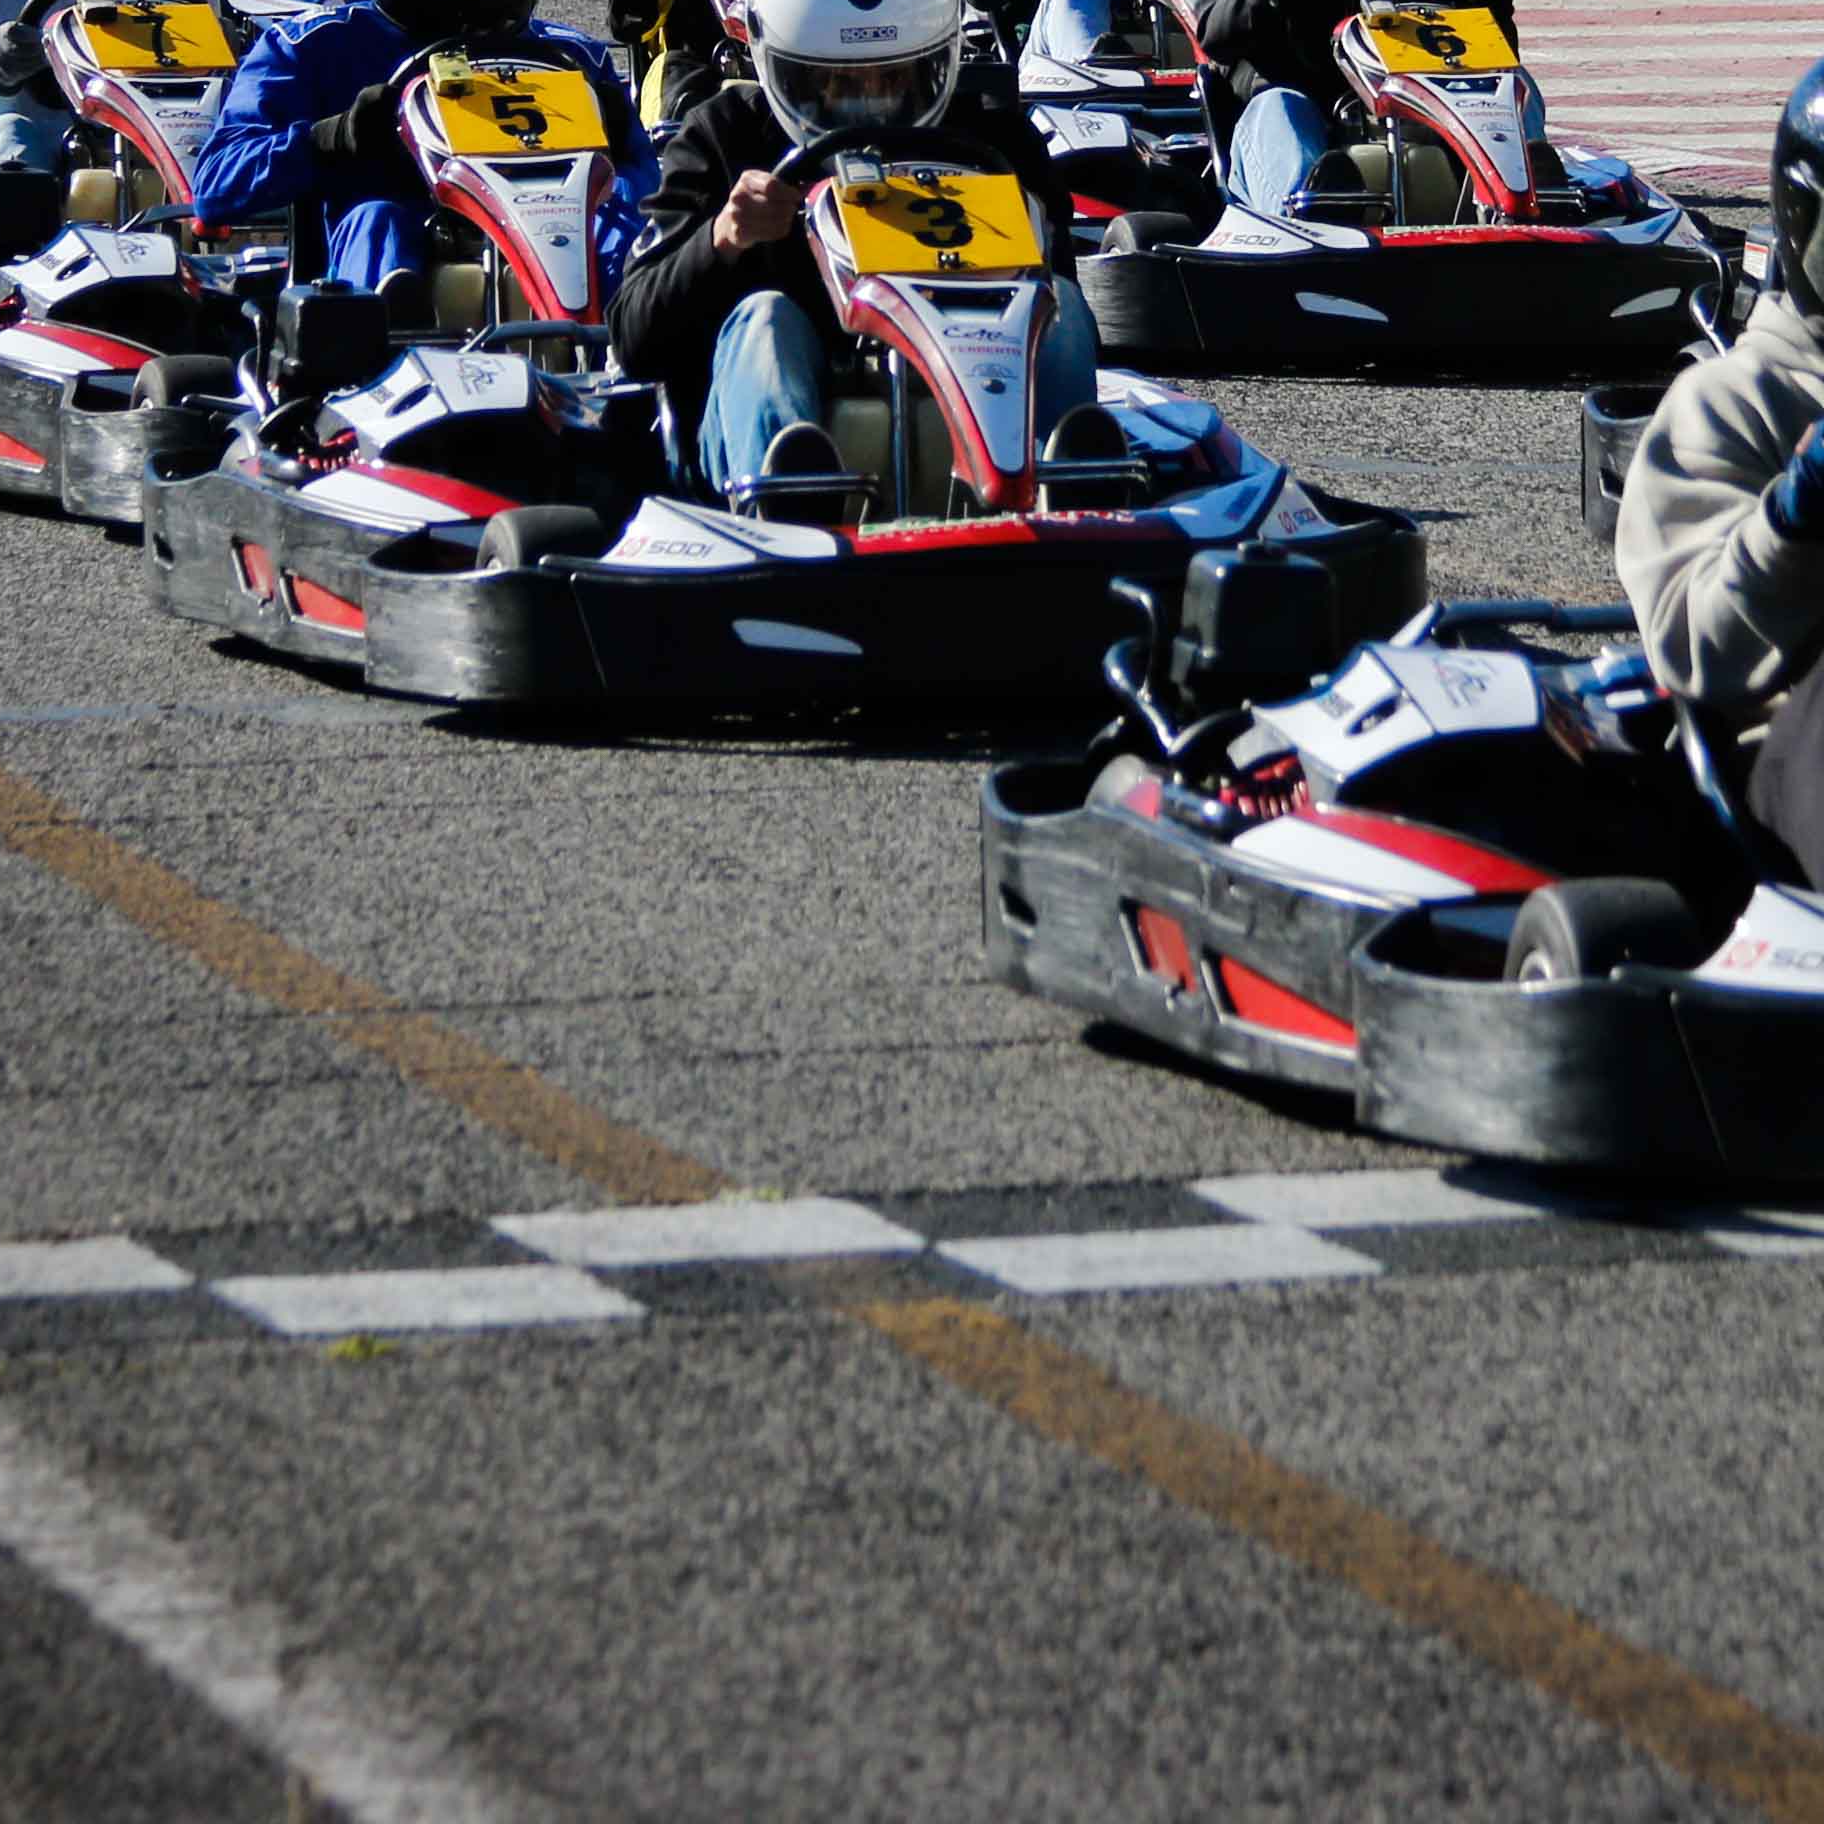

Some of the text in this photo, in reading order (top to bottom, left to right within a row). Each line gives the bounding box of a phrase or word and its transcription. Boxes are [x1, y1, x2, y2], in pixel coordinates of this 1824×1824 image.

[132, 12, 173, 65] 7
[1415, 23, 1468, 58] 6
[490, 94, 548, 138] 5
[907, 198, 974, 249] 3
[1230, 234, 1282, 249] SODI
[647, 540, 717, 560] SODI
